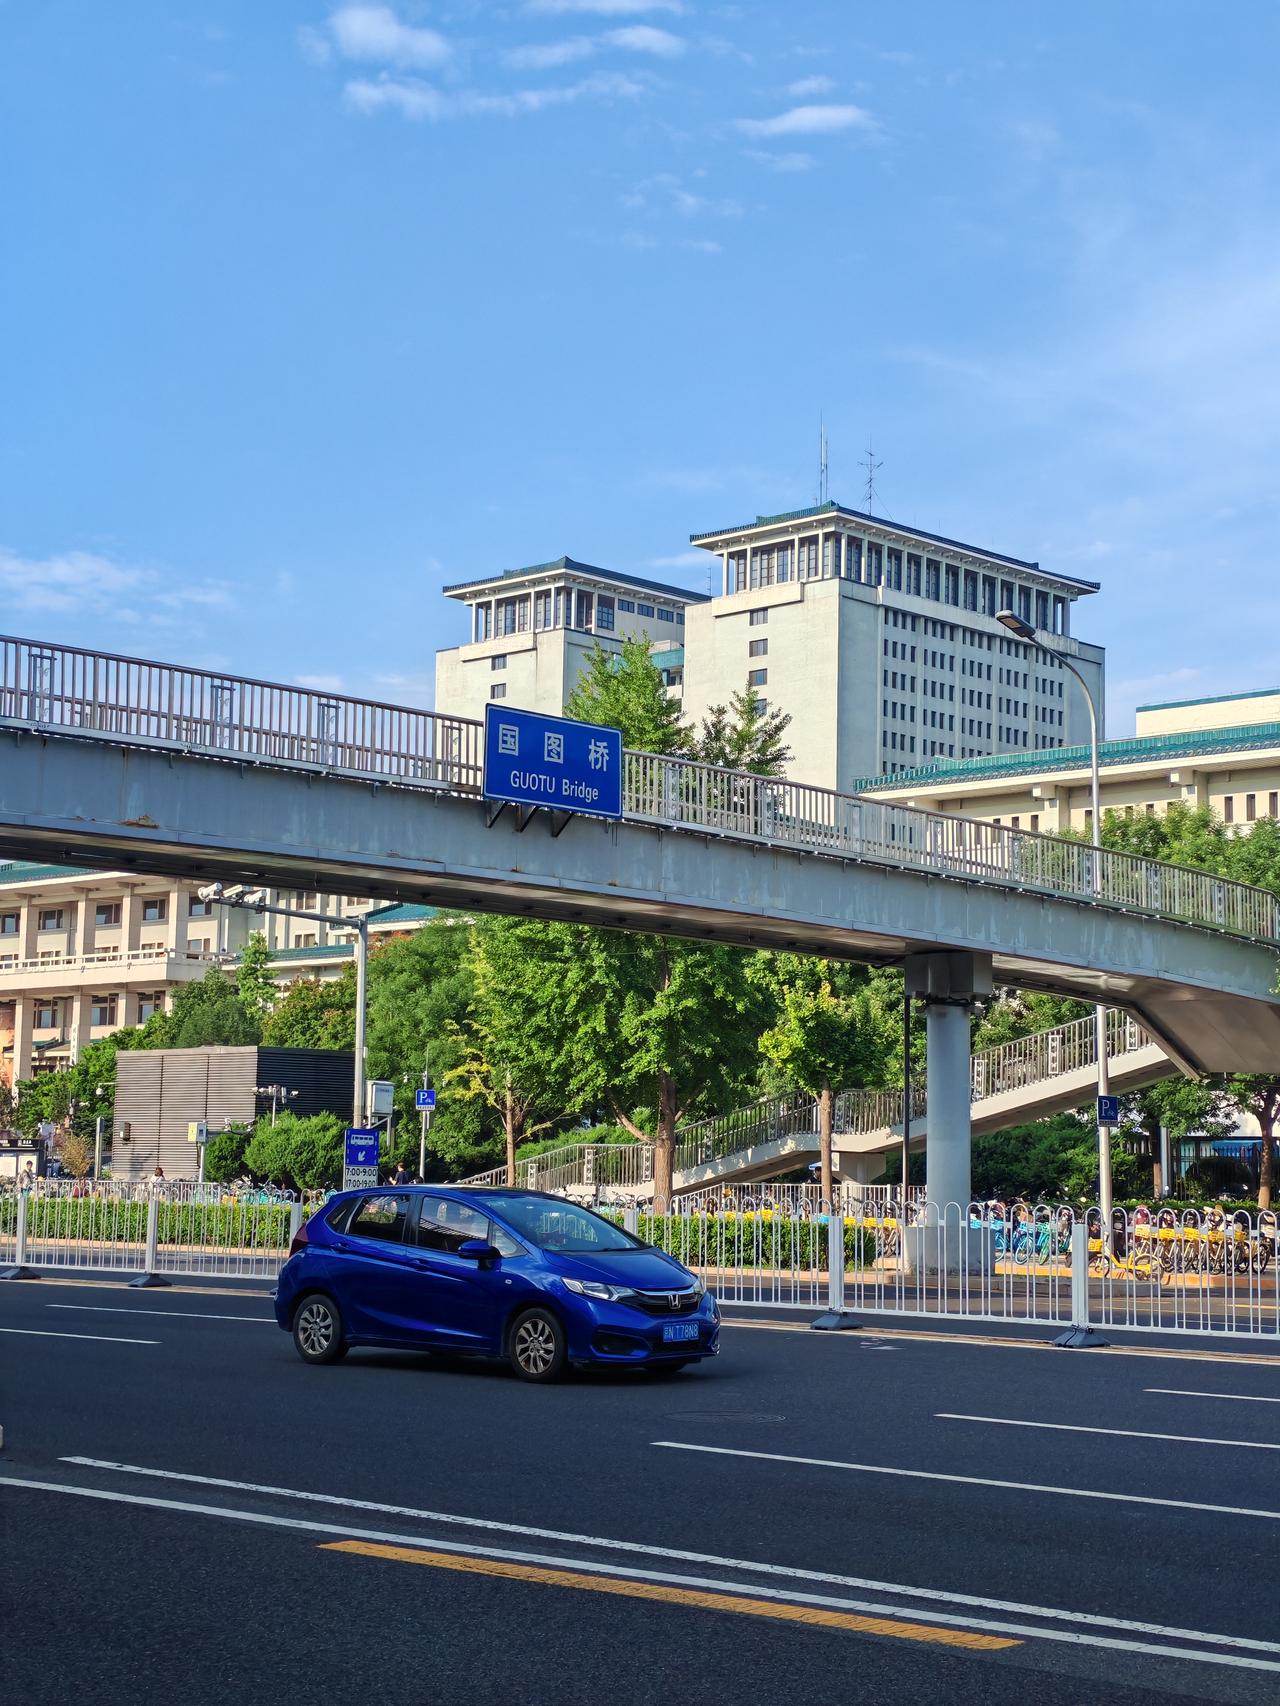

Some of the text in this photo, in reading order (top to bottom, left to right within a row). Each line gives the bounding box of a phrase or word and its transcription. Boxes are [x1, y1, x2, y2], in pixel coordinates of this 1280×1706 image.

[498, 723, 610, 772] 国图桥
[510, 770, 599, 803] GUOTU Bridge
[420, 1091, 428, 1104] P
[1101, 1099, 1110, 1117] P
[345, 1167, 377, 1177] 7:00-9:00
